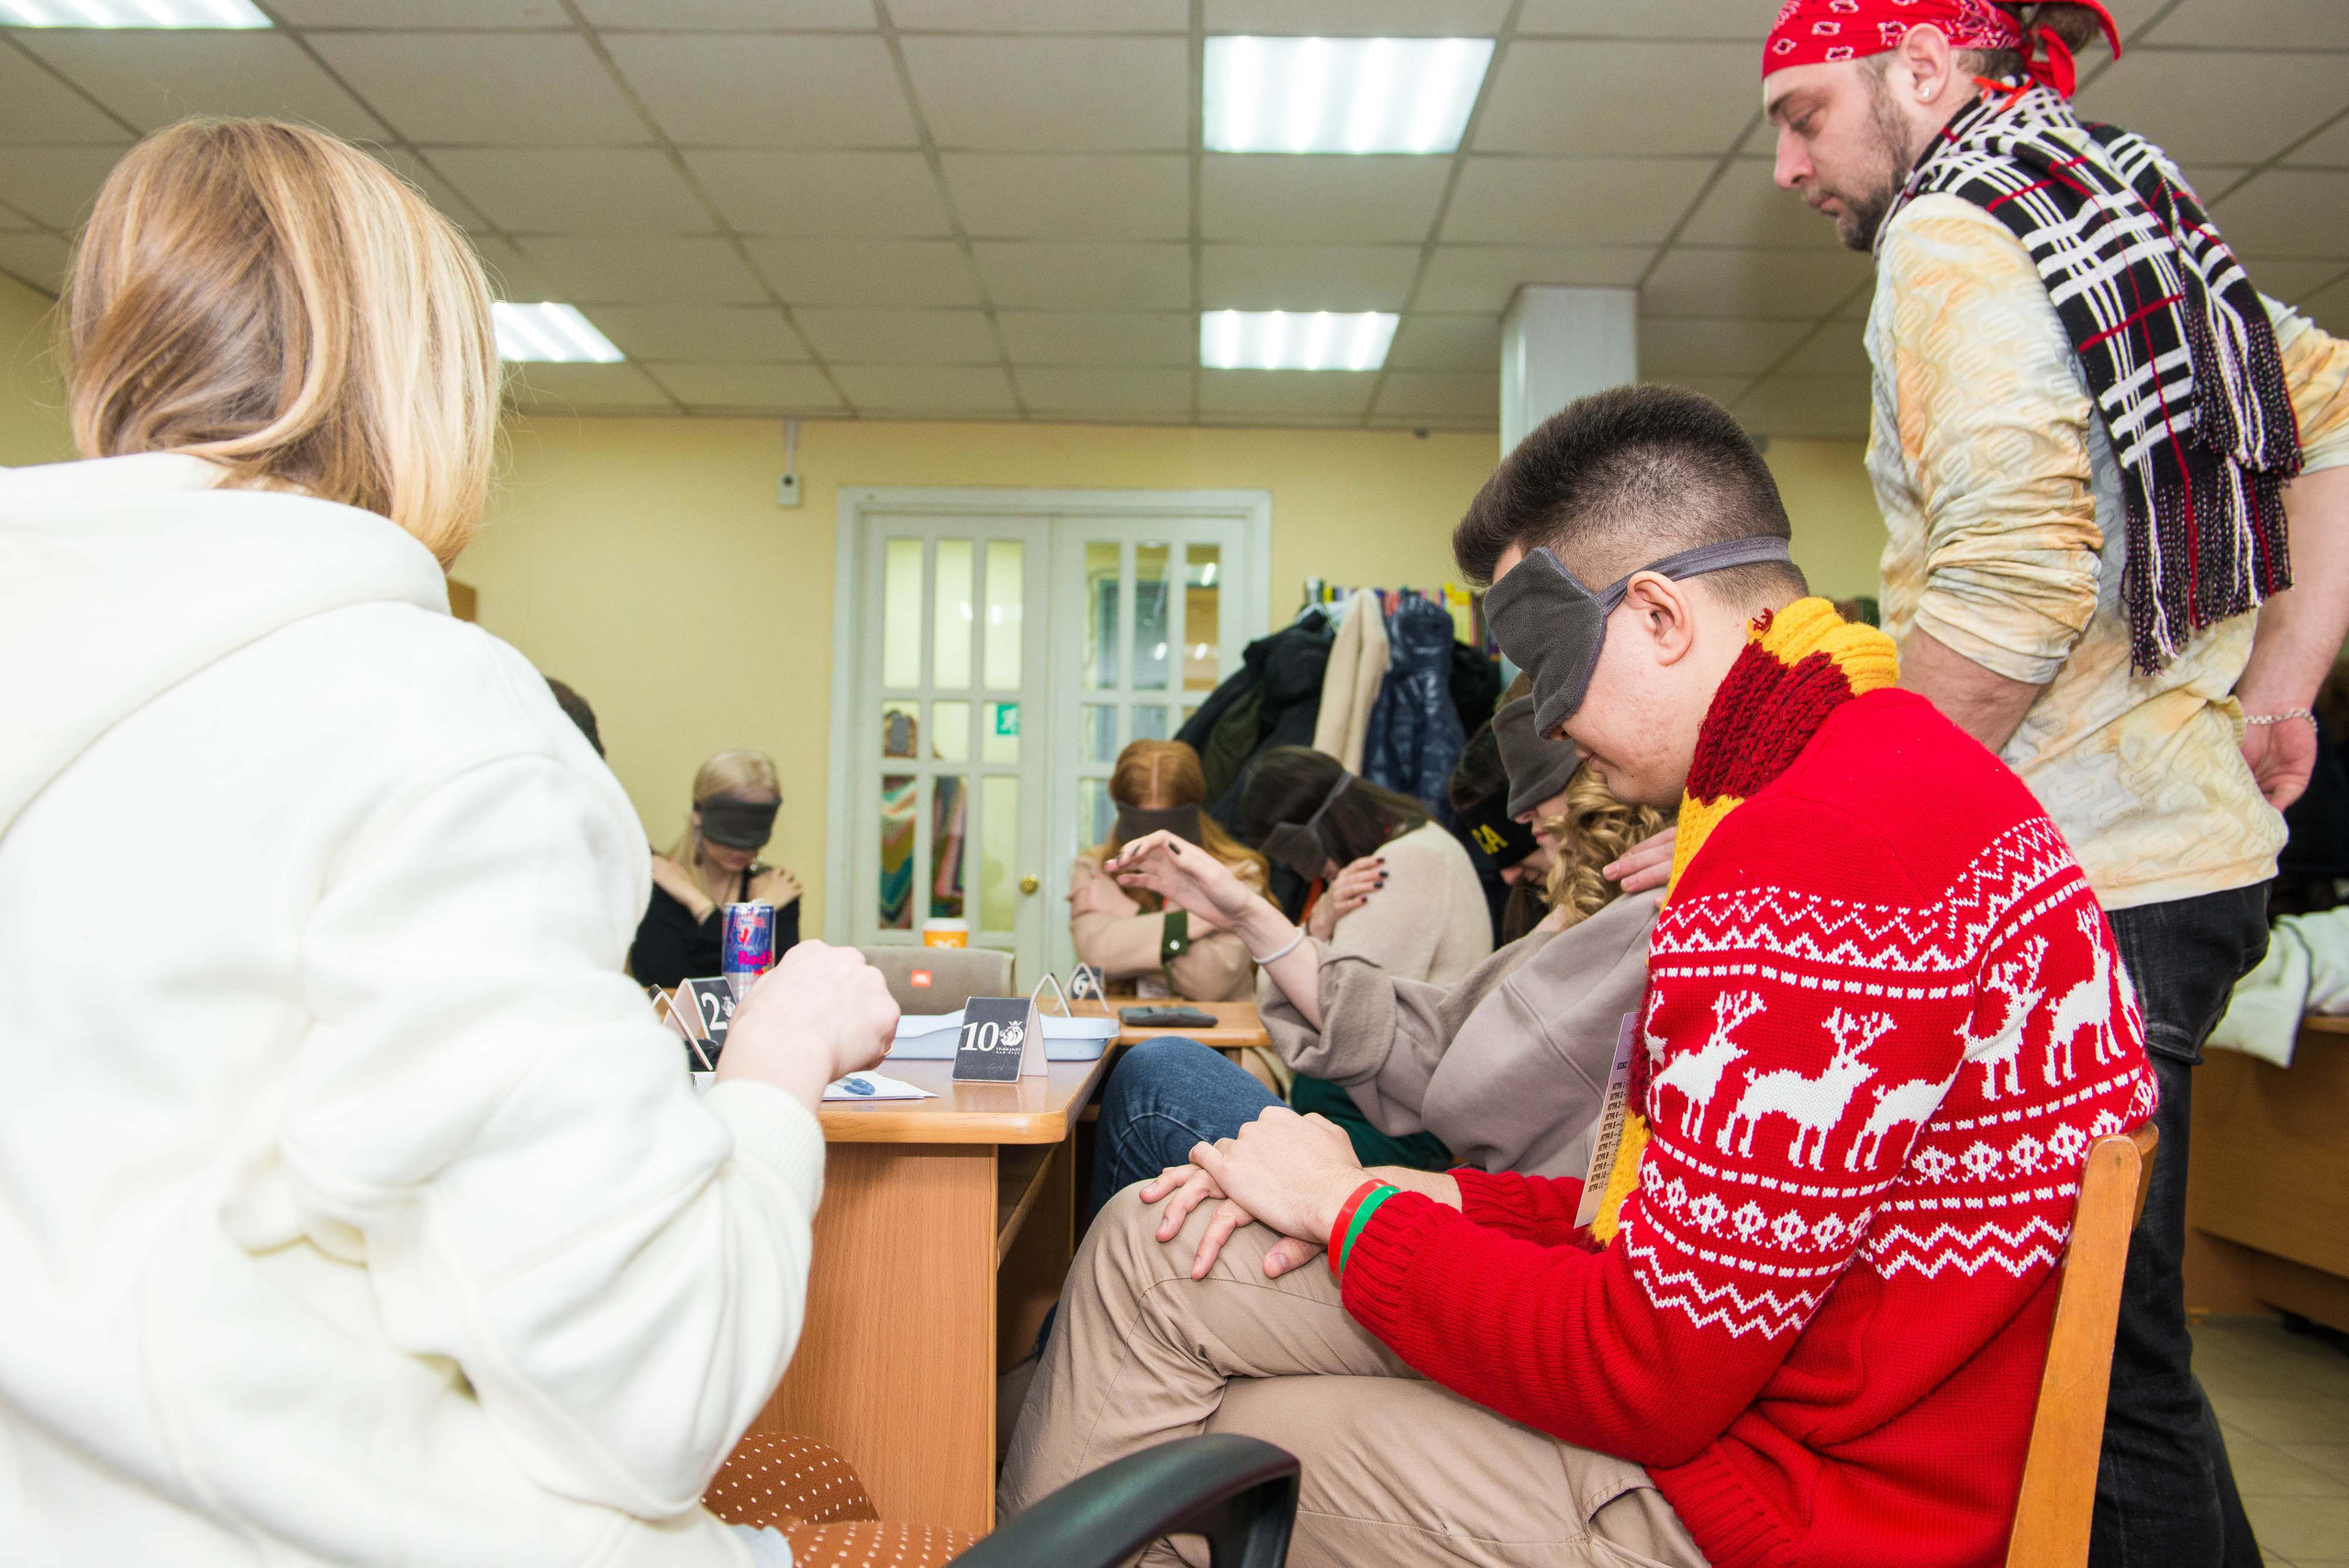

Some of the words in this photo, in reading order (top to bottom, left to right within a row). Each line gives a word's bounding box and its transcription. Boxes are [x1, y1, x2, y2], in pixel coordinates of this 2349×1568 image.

[737, 950, 766, 965] Red
[1073, 973, 1089, 995] 6
[701, 992, 728, 1031] 2
[960, 1021, 999, 1051] 10
